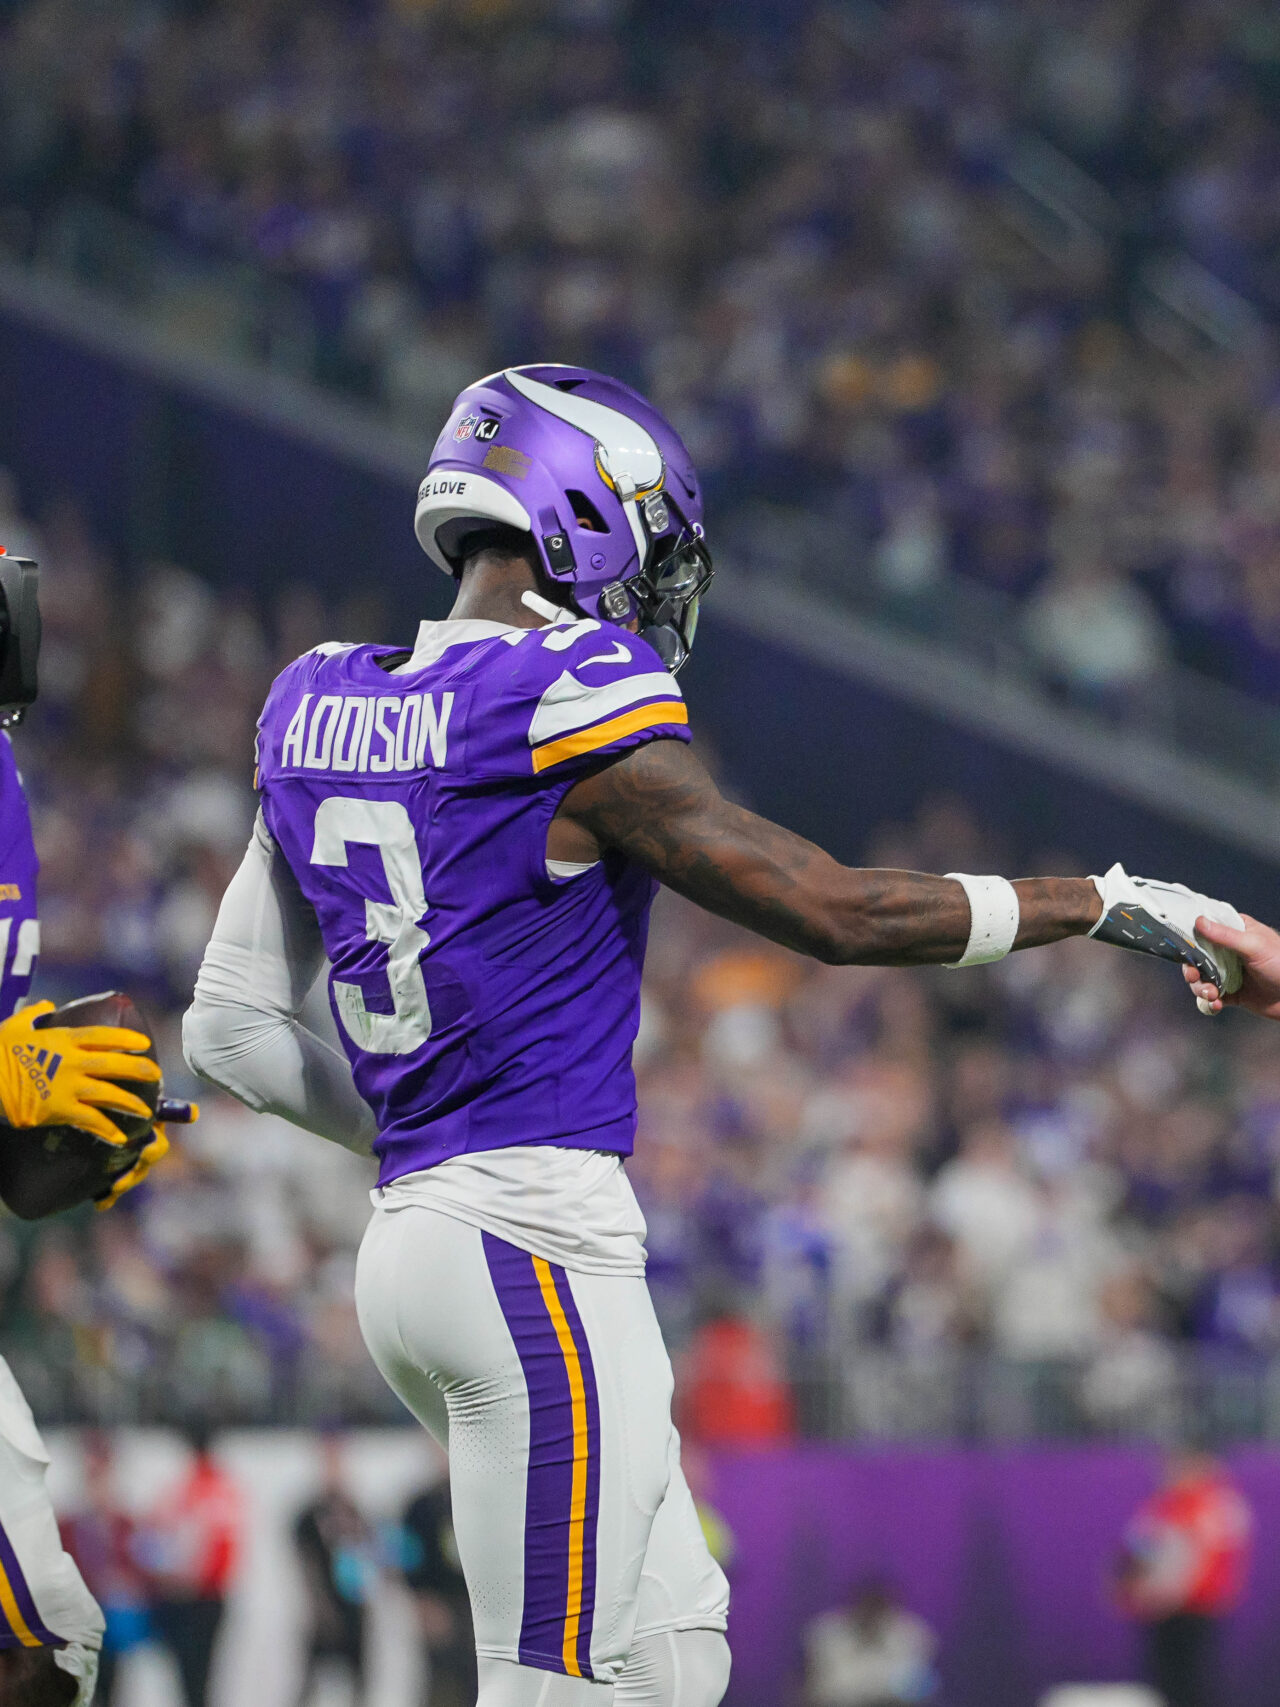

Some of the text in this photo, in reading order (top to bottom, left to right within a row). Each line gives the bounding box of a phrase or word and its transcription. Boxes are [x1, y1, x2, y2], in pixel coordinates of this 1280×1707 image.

[474, 421, 499, 439] KJ
[432, 481, 466, 495] LOVE
[281, 692, 455, 773] ADDISON
[310, 796, 432, 1056] 3
[12, 1044, 52, 1101] adidas
